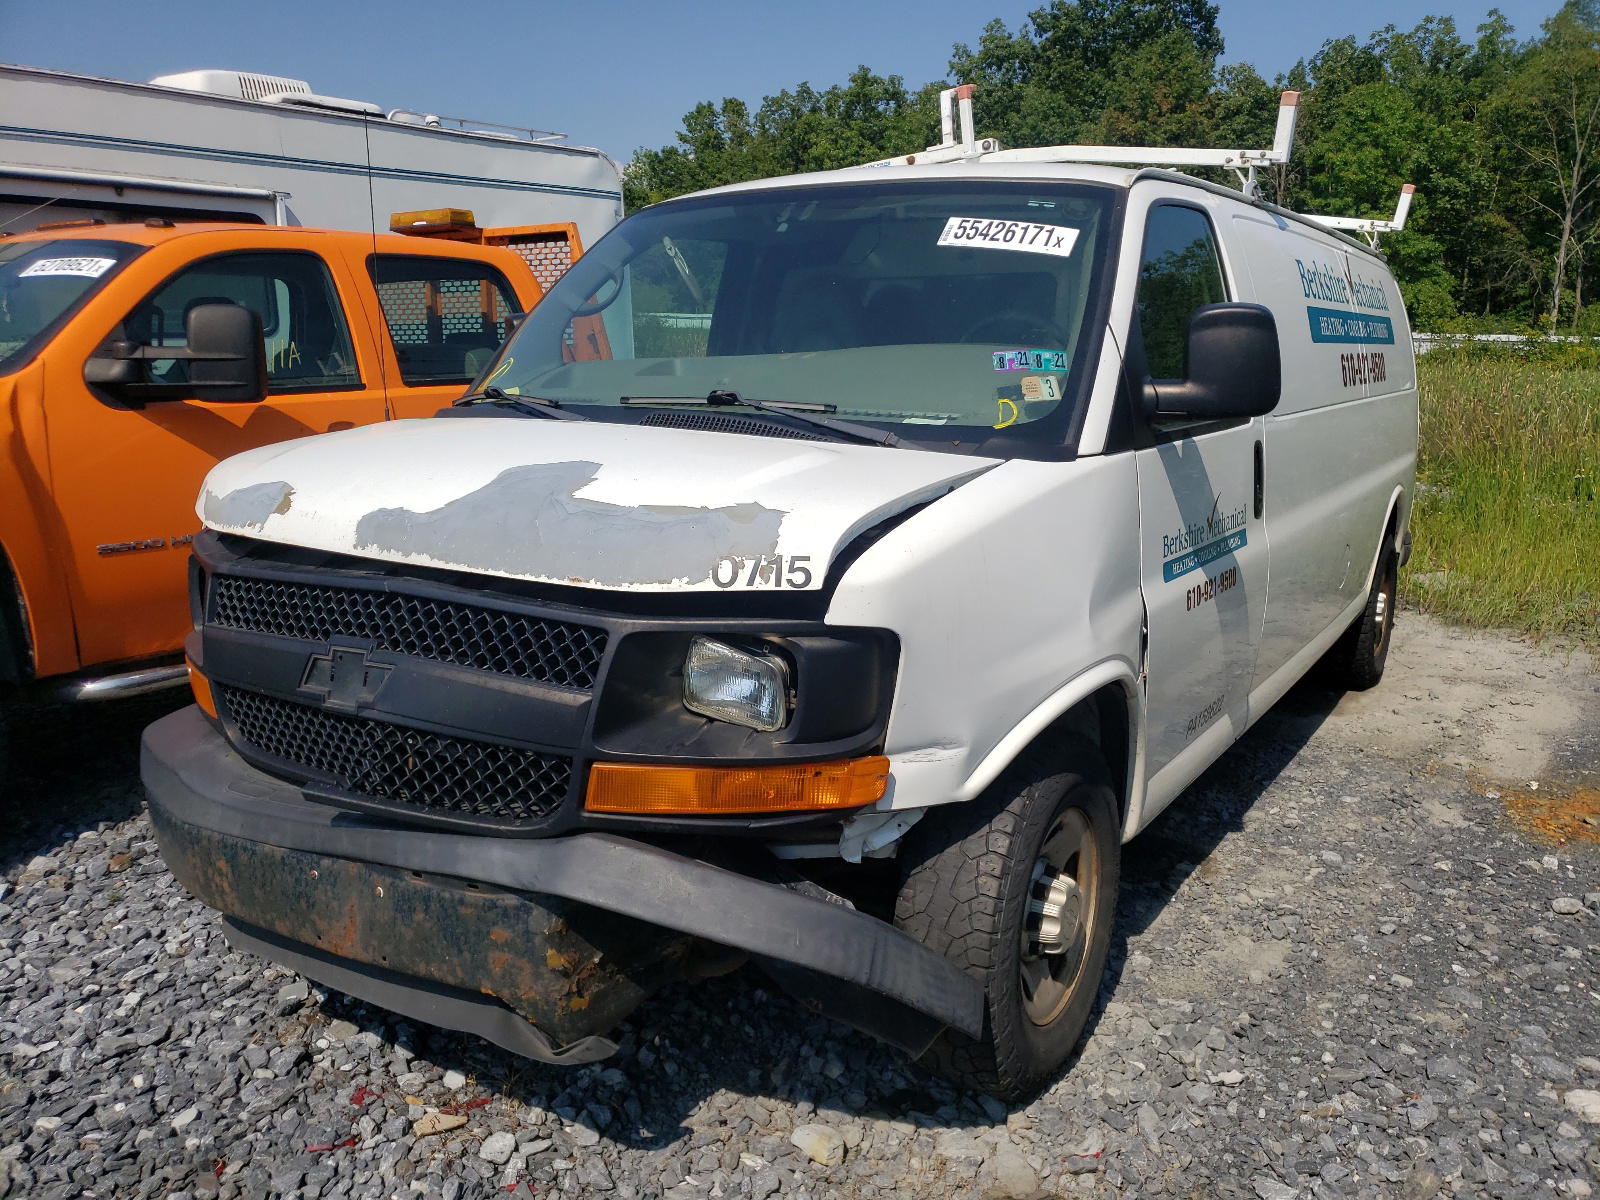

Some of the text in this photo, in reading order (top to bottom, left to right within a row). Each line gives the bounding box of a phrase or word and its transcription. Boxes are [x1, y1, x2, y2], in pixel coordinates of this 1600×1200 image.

[1294, 258, 1350, 304] Berkshire
[1319, 316, 1345, 336] HEATING
[999, 351, 1030, 369] 8 21
[1035, 353, 1066, 369] 8 21
[1045, 379, 1055, 398] 3
[992, 398, 1018, 430] D
[1163, 503, 1247, 559] Berkshire Mechanical
[711, 554, 812, 589] 0715
[1172, 555, 1195, 575] HEATING
[1186, 566, 1238, 612] 610-921-9500
